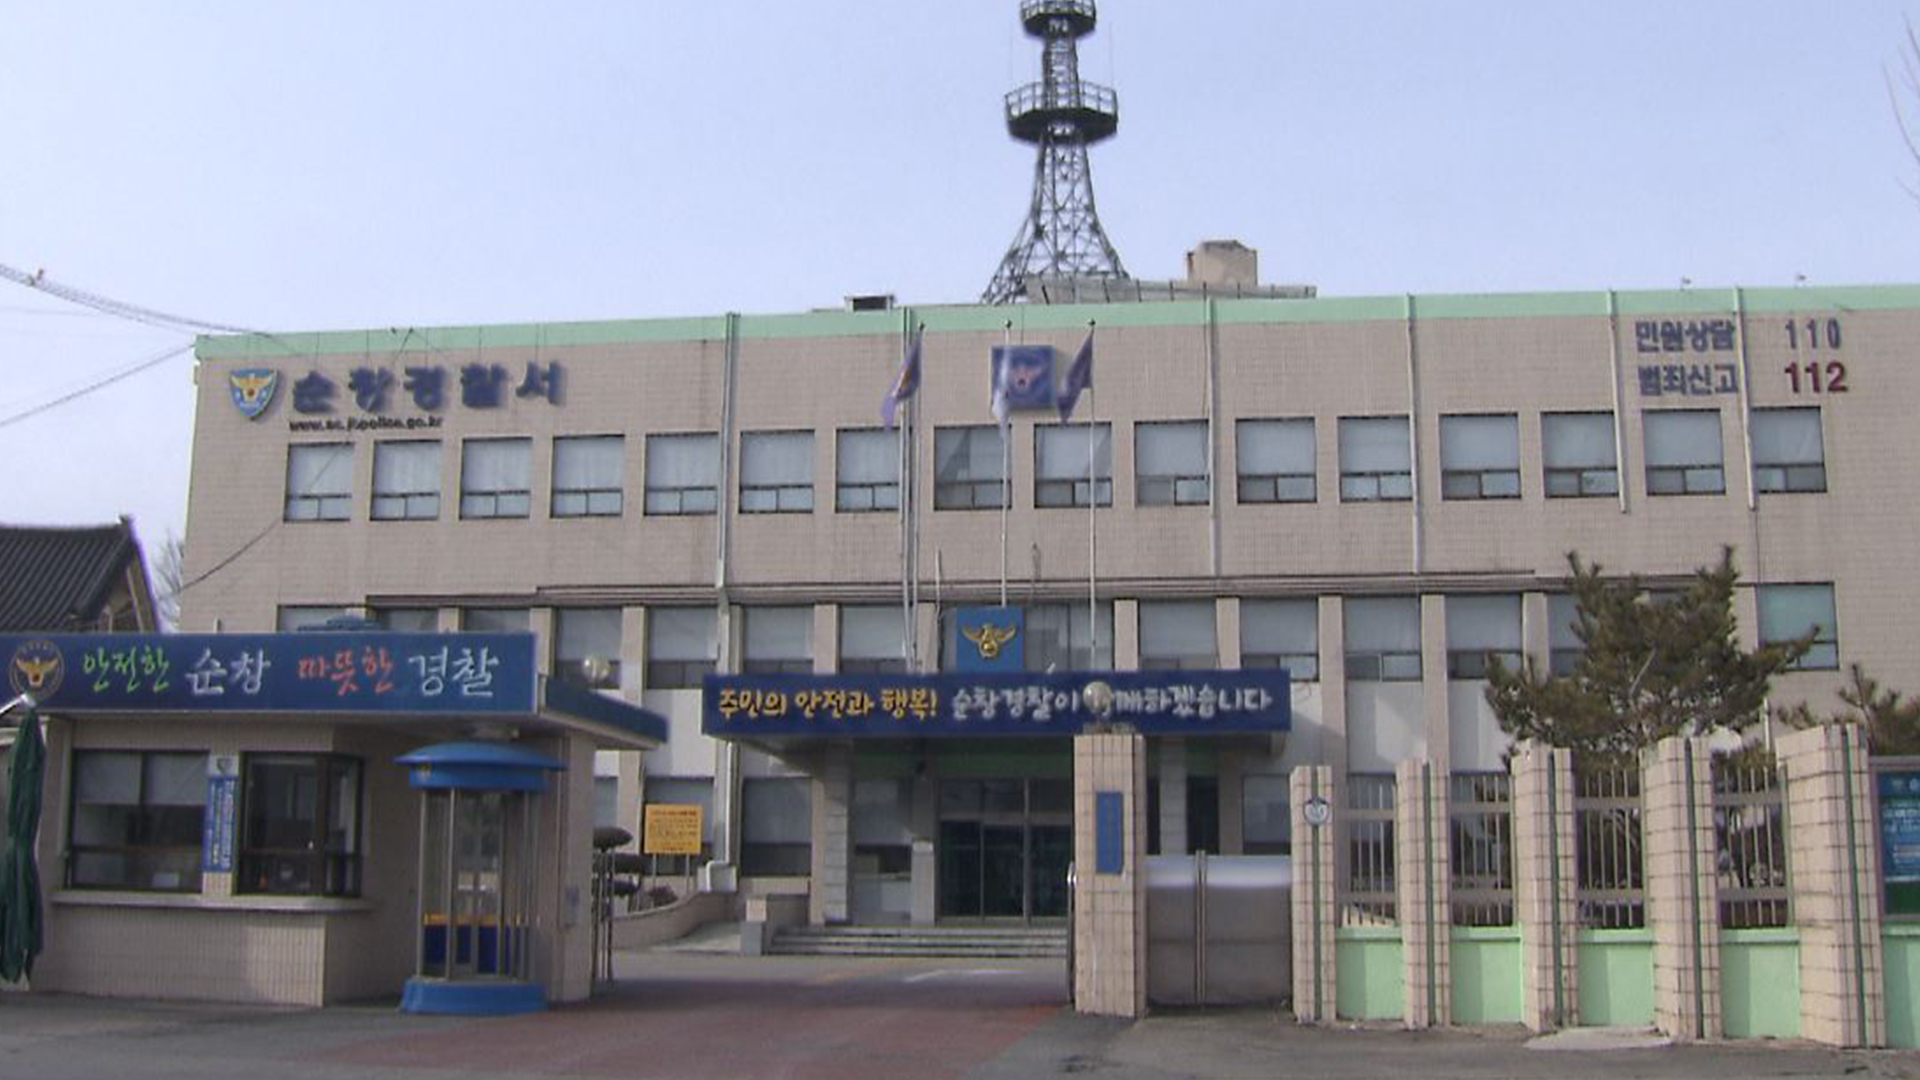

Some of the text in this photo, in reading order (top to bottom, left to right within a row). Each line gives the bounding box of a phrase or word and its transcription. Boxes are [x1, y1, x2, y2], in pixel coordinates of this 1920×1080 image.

[1635, 317, 1842, 352] 민원상담 110
[292, 360, 566, 413] 순창경찰서
[1638, 361, 1848, 396] 범죄신고 112
[83, 645, 499, 697] 안전한 순창 따뜻한 경찰
[718, 685, 1273, 721] 주민의 안전과 행복! 순창경찰이 께하겠습니다
